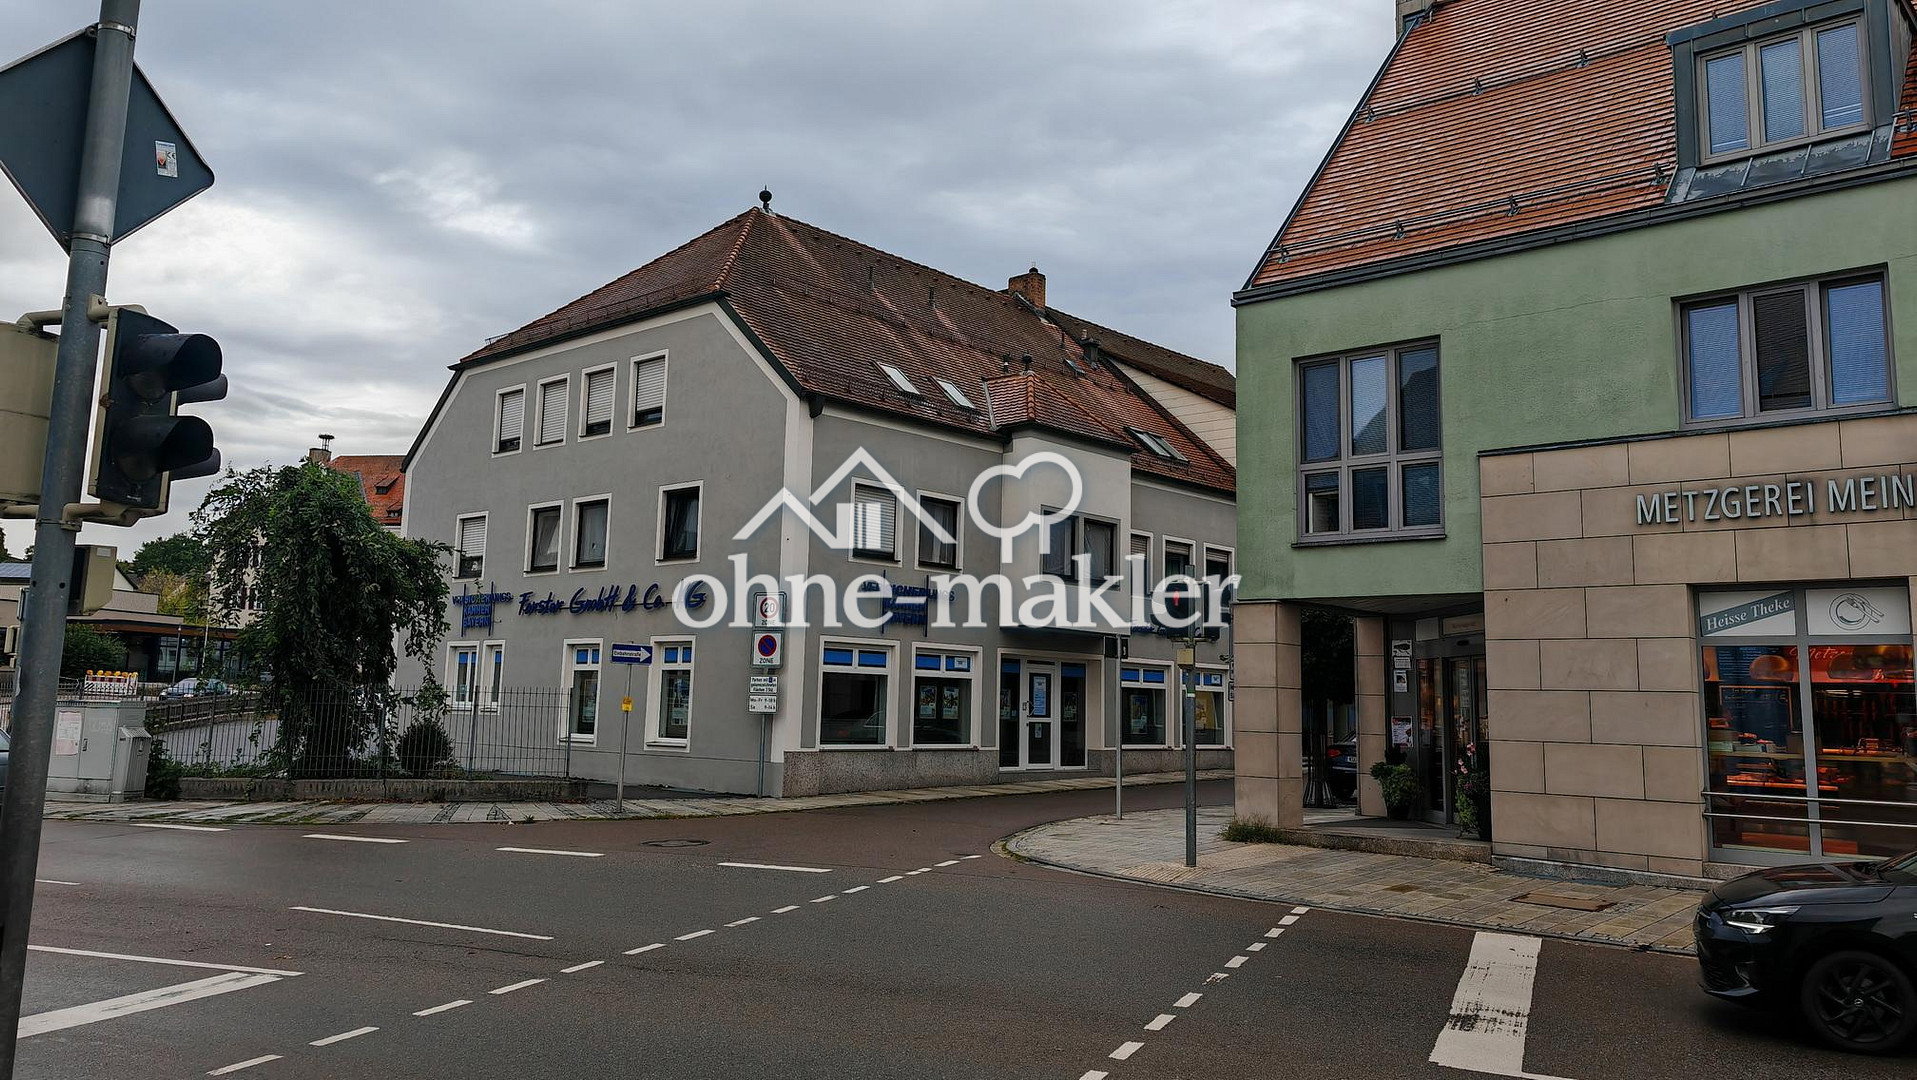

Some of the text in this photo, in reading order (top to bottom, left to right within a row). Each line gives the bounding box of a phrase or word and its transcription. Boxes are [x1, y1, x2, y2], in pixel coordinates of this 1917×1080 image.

[1636, 473, 1915, 525] METZGEREI MEIN
[1705, 597, 1791, 632] Heisse Theke
